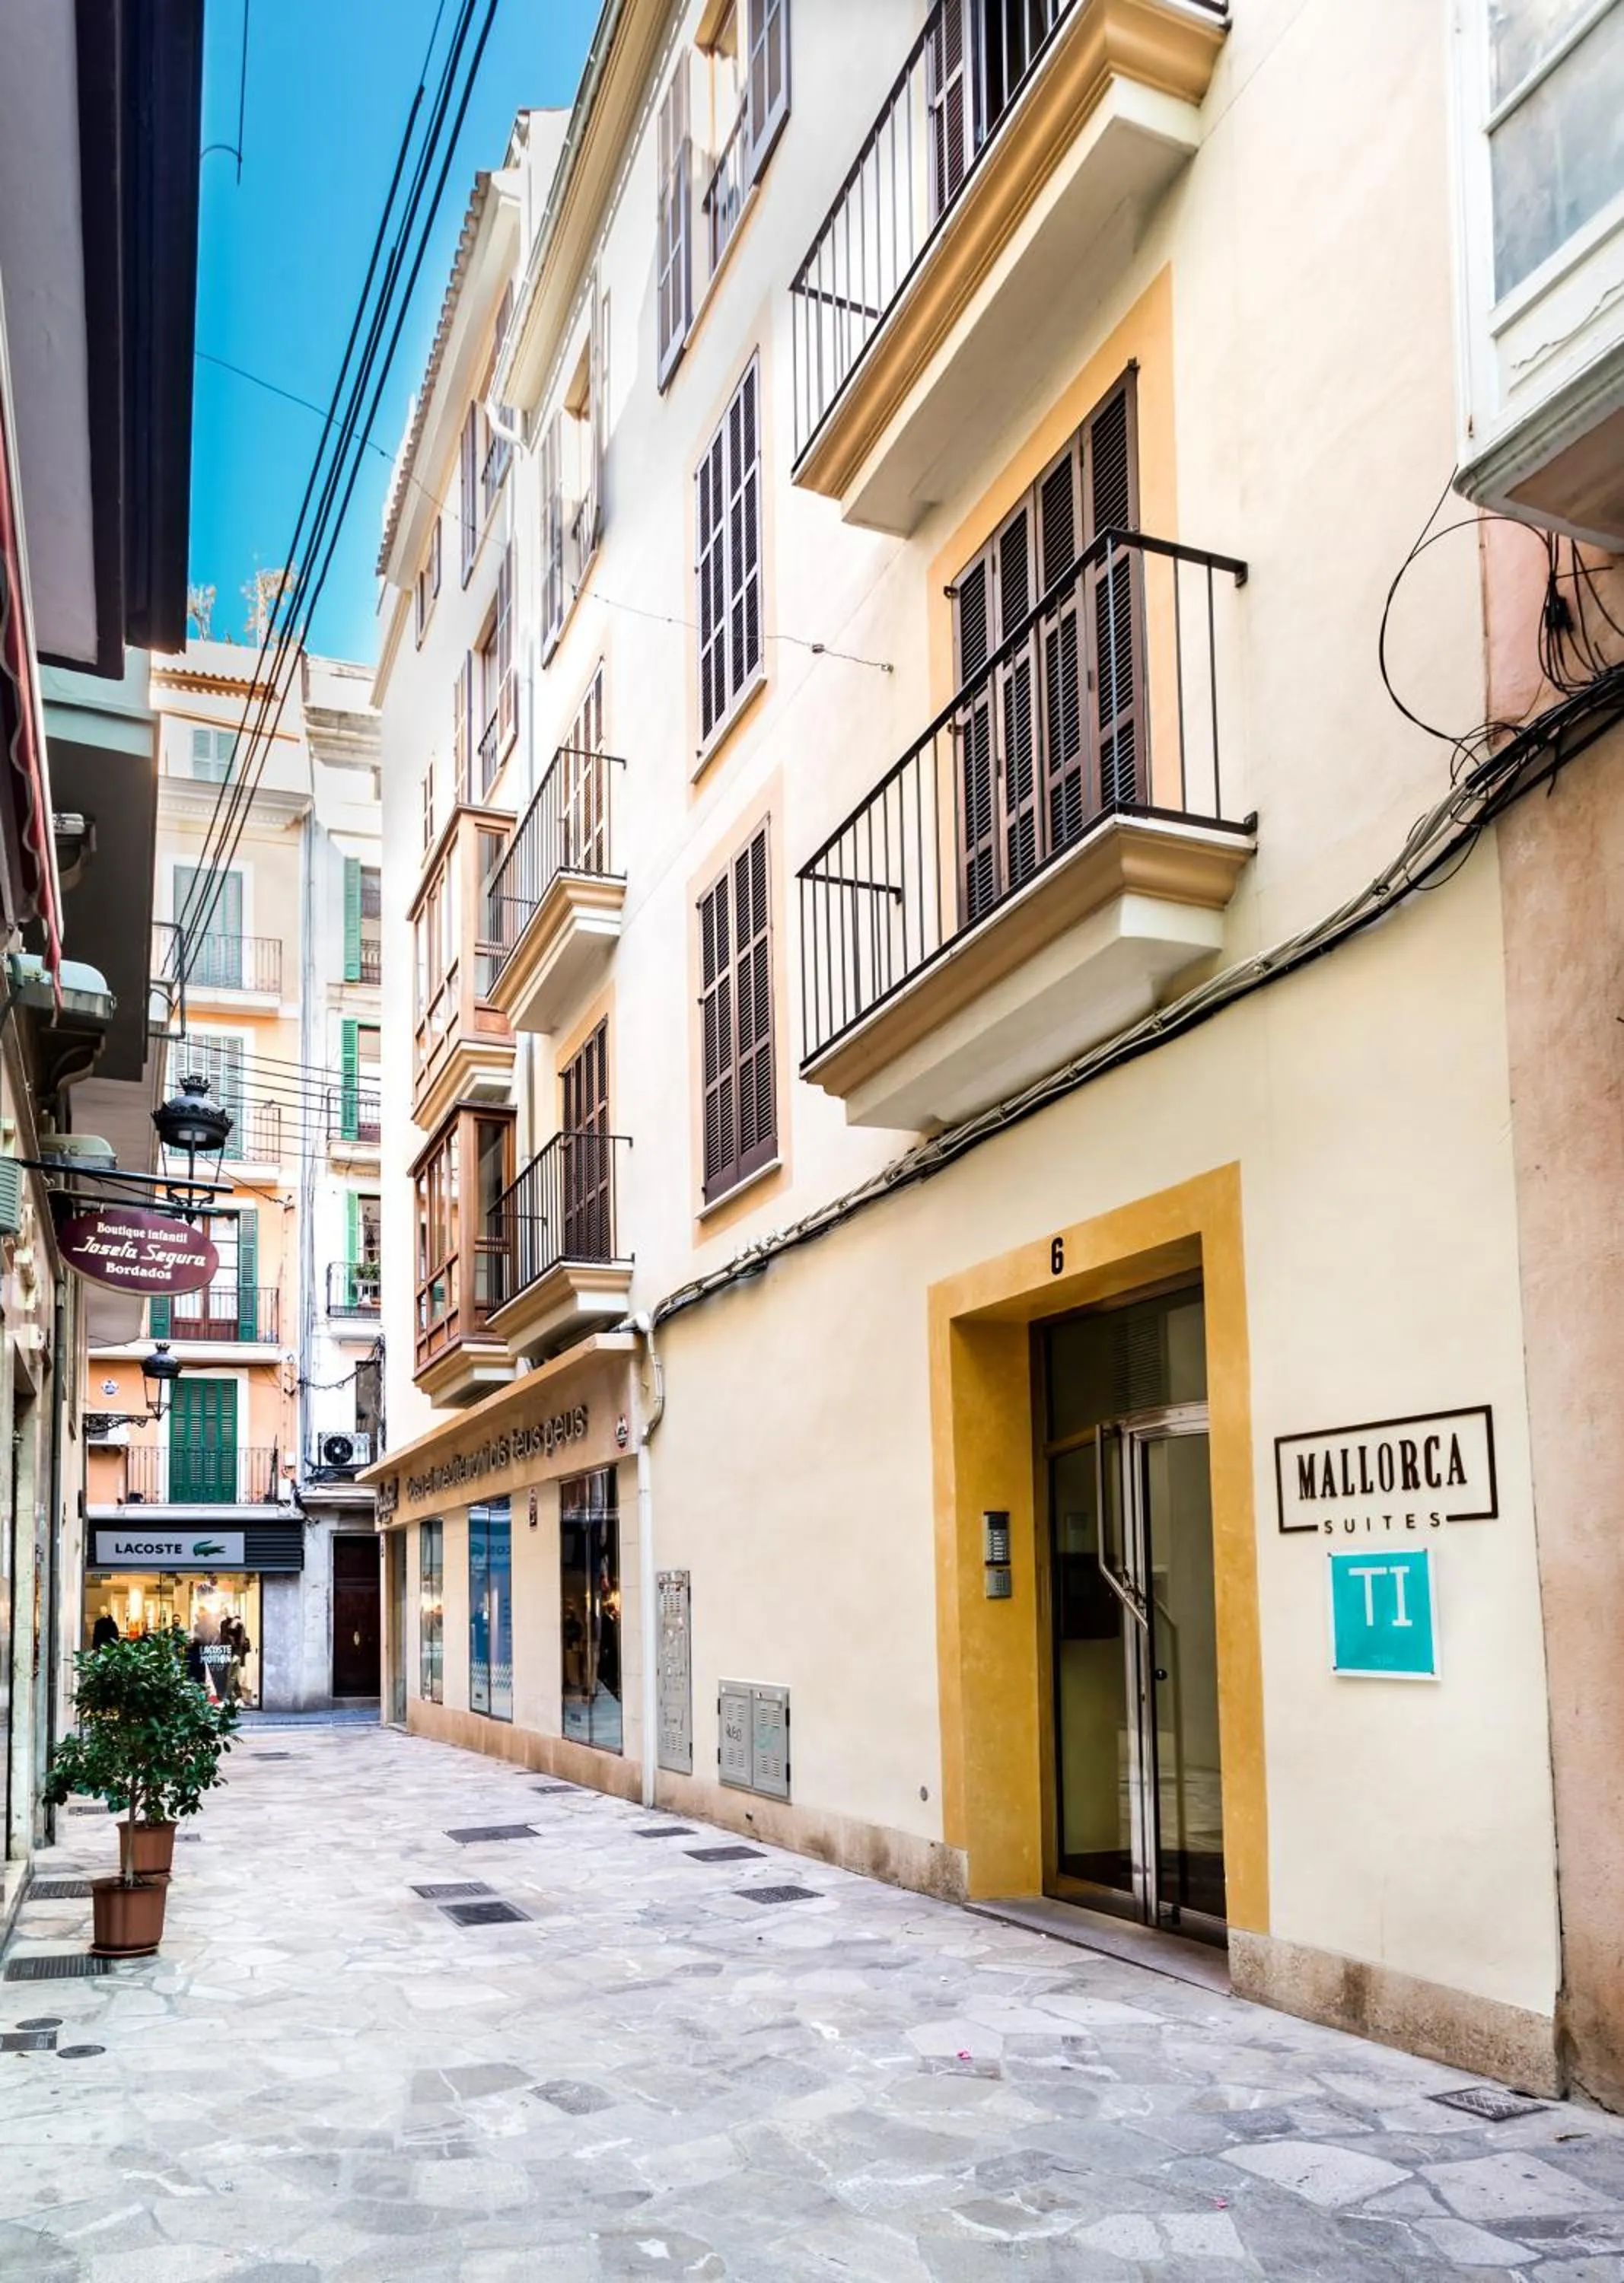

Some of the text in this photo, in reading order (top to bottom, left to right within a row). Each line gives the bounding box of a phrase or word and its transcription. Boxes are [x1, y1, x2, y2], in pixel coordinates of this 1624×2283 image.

[97, 1221, 145, 1239] Boutique
[72, 1235, 206, 1269] Josefa Segura
[1051, 1237, 1064, 1275] 6
[105, 1260, 173, 1280] Bordados
[543, 1404, 589, 1458] peus
[1296, 1432, 1467, 1500] MALLORCA
[1323, 1511, 1441, 1534] SUITES
[114, 1543, 183, 1555] LACOSTE
[1348, 1565, 1413, 1627] TI
